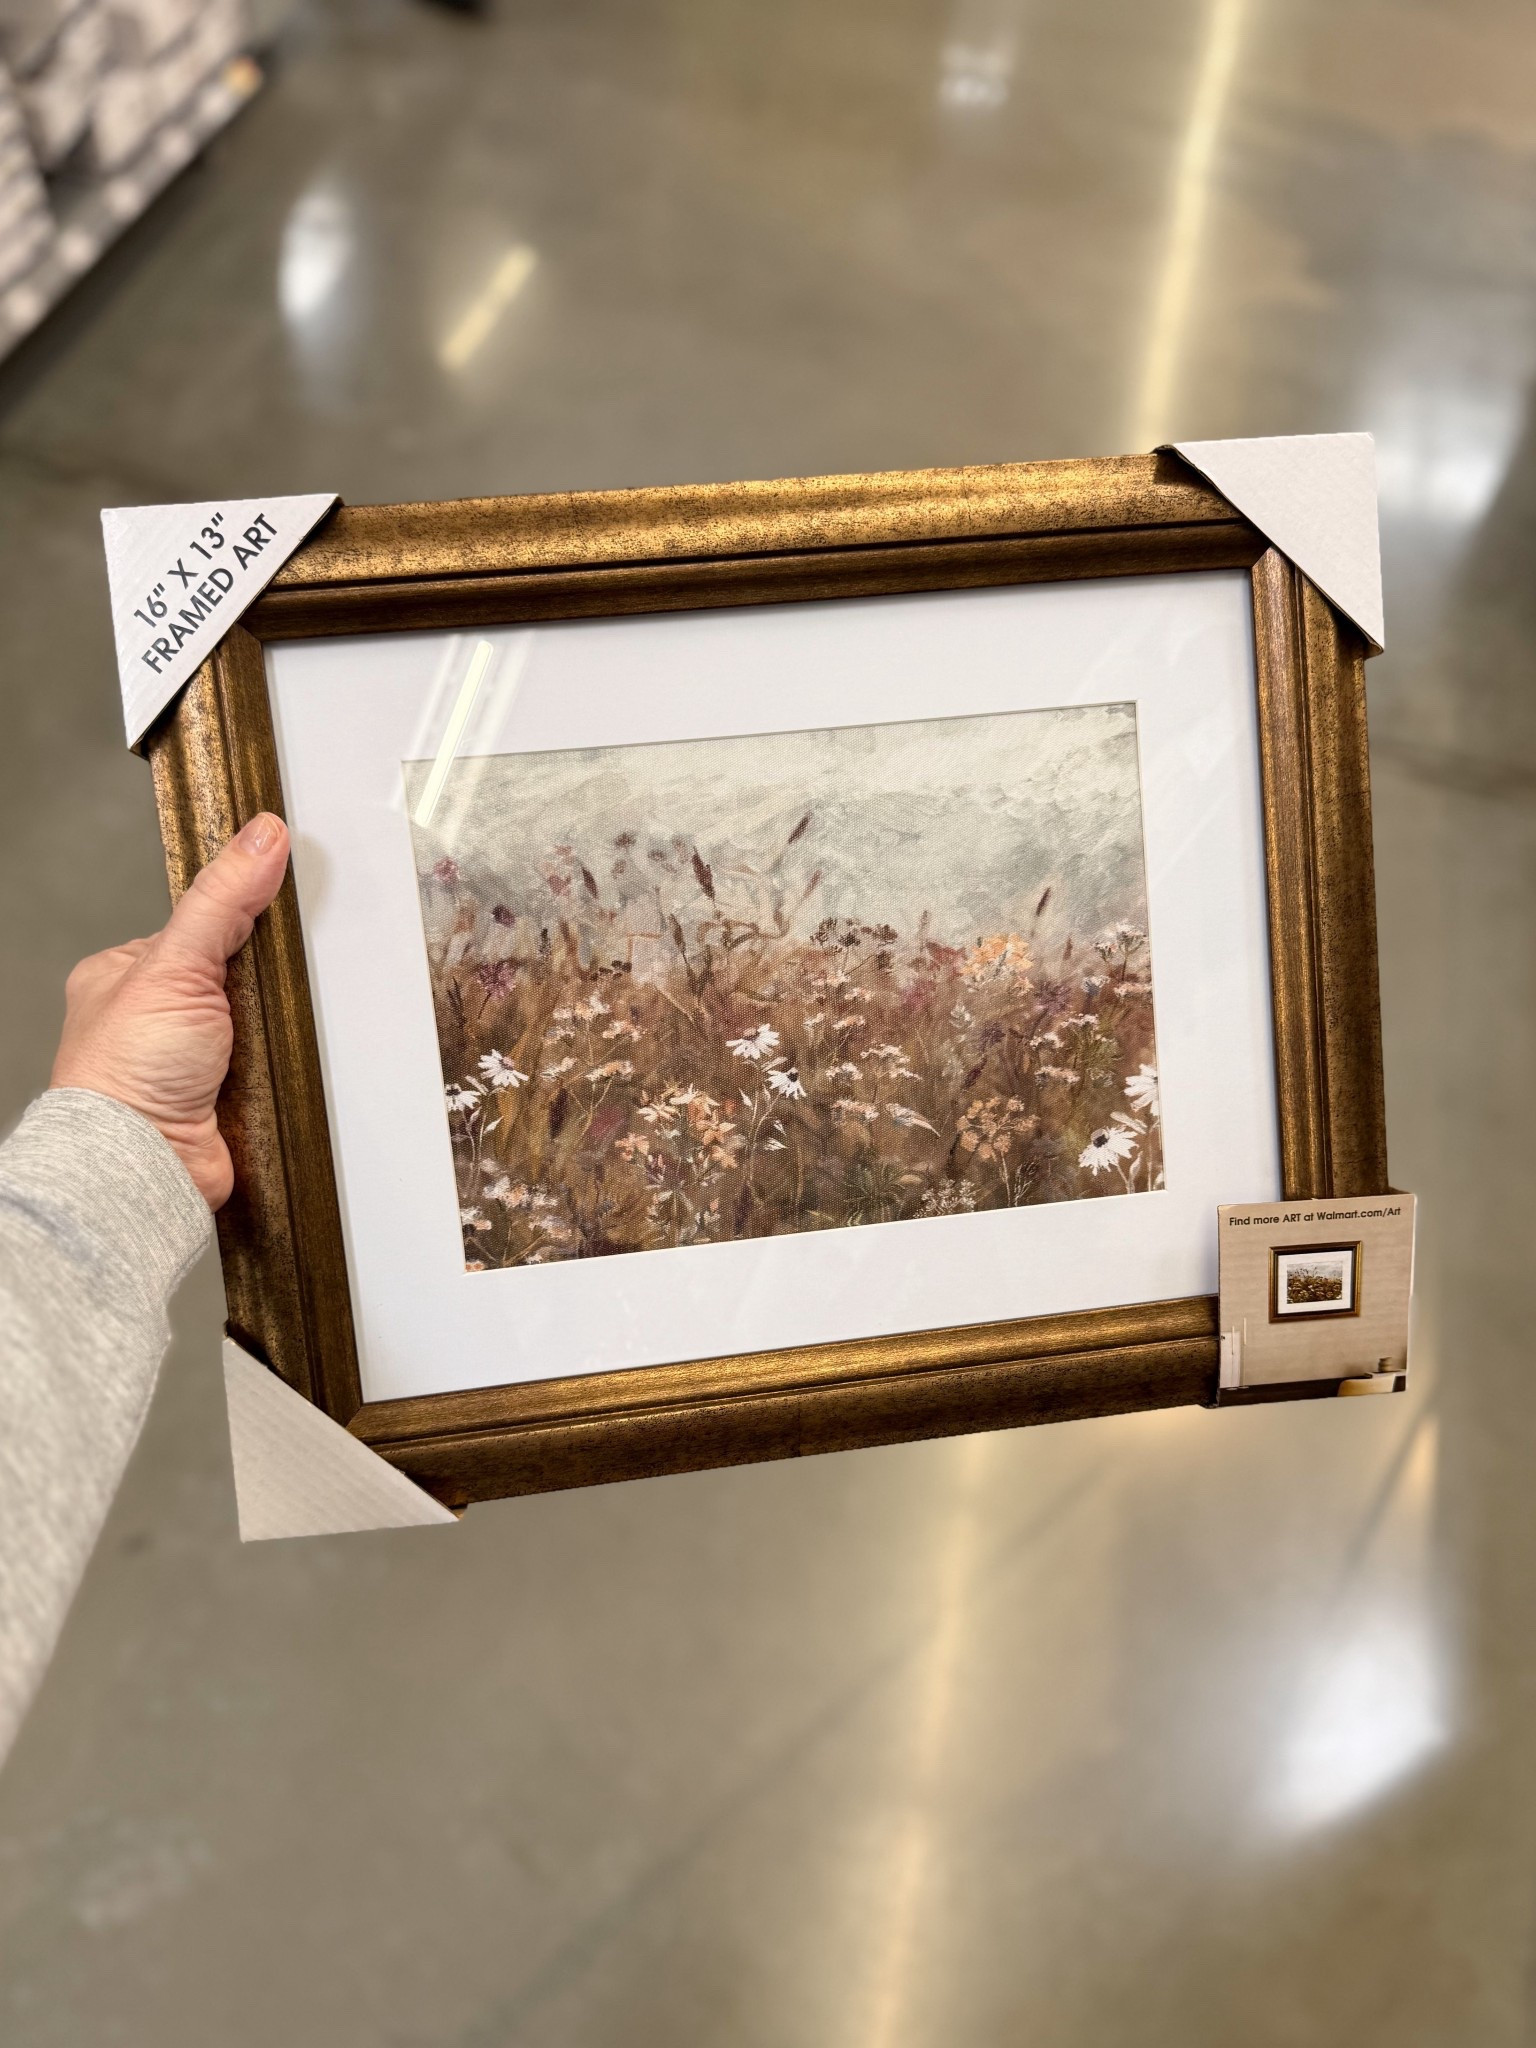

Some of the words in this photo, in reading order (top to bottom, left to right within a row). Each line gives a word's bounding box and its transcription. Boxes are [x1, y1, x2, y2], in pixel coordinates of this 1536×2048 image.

[134, 583, 168, 628] 16"
[167, 558, 199, 590] X
[190, 512, 225, 560] 13"
[141, 568, 234, 674] FRAMED
[232, 513, 278, 571] ART
[1229, 1216, 1250, 1226] Find
[1253, 1216, 1279, 1225] more
[1282, 1213, 1301, 1223] ART
[1303, 1212, 1314, 1222] at
[1317, 1207, 1401, 1220] Walmart.com/Art
